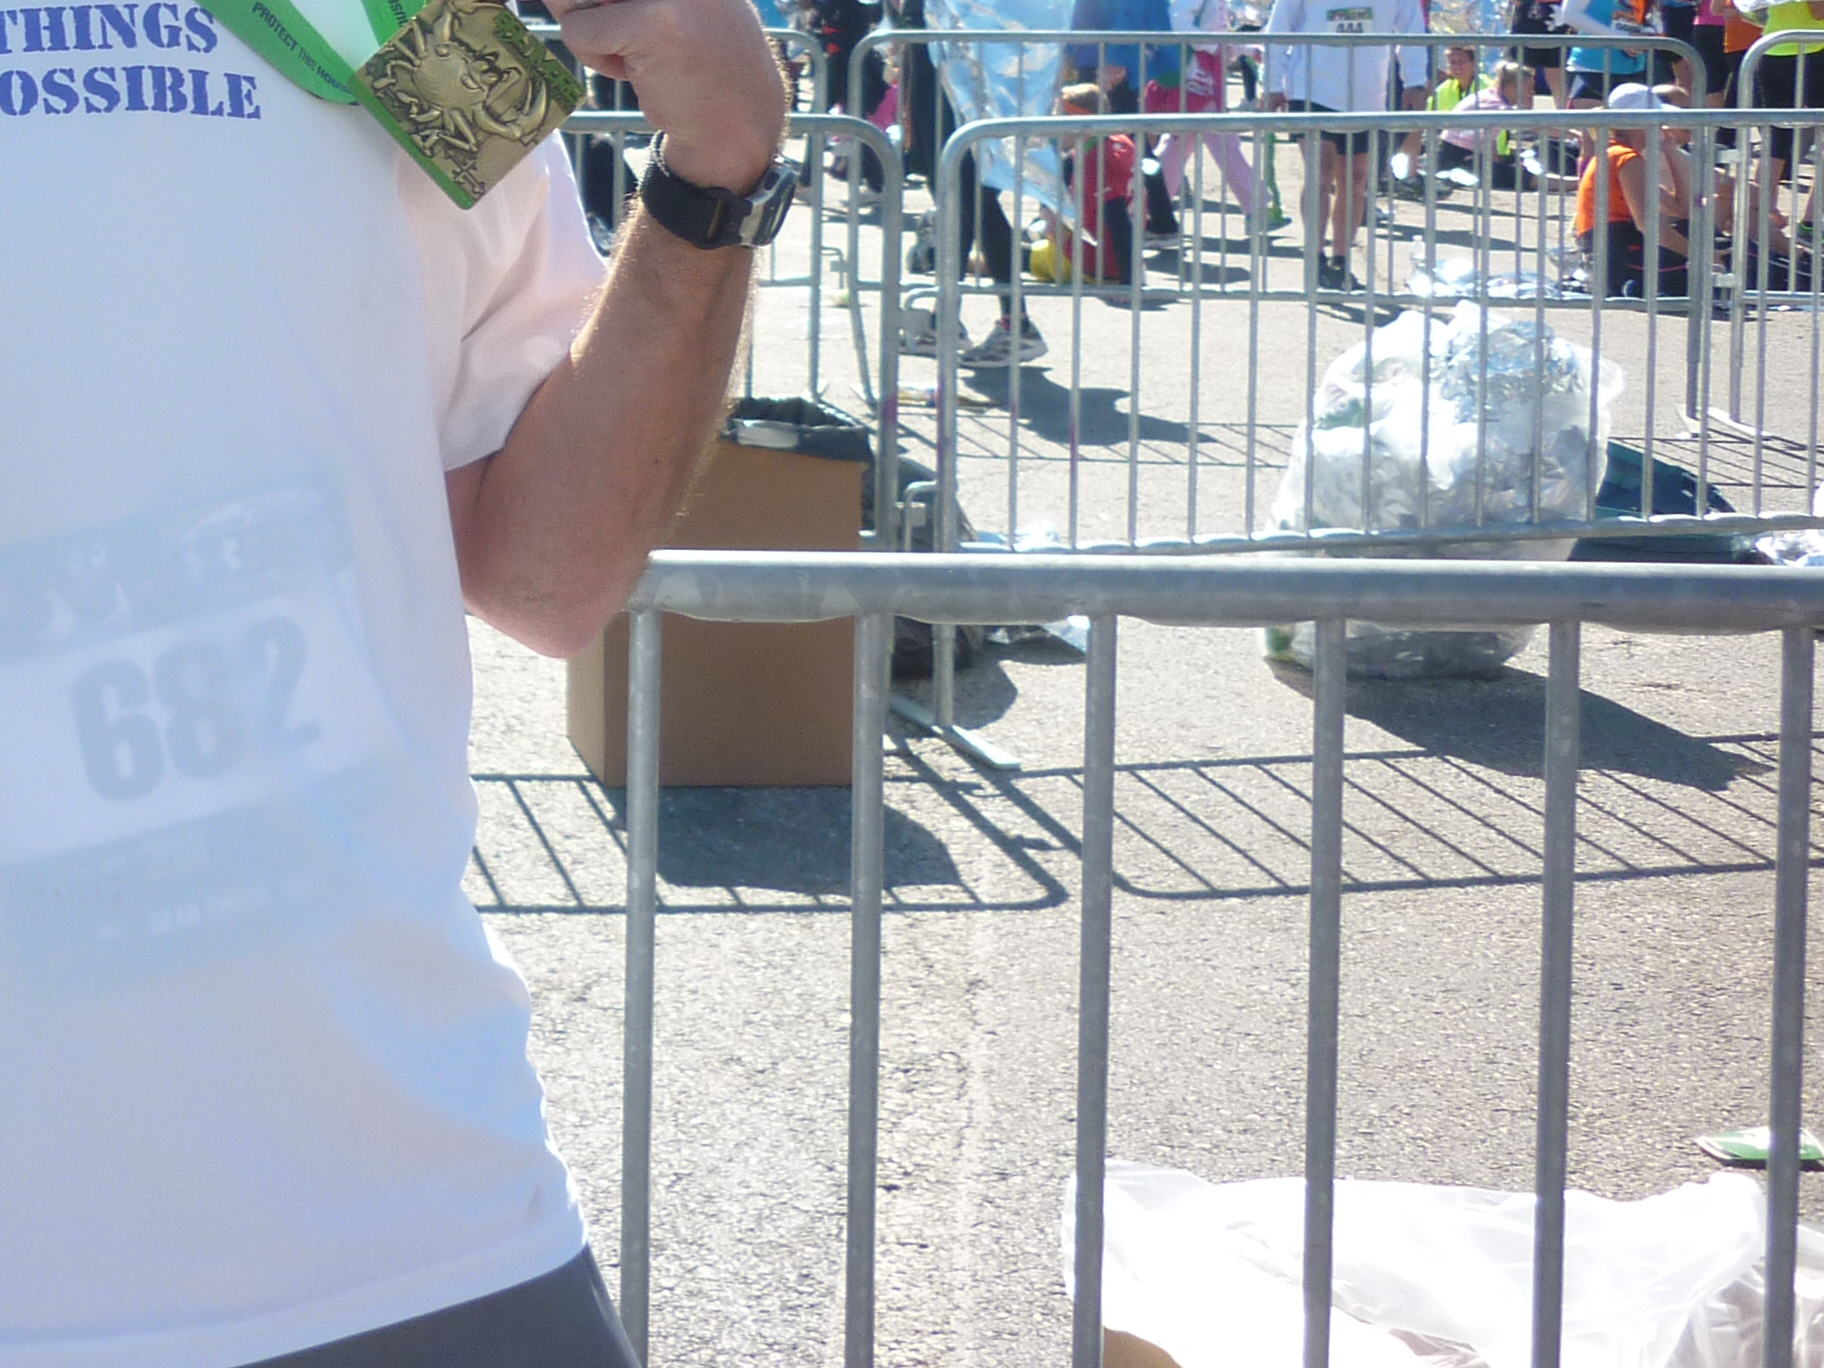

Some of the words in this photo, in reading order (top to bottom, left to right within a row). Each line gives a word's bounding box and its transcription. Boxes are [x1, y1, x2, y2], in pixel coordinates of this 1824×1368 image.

[250, 1, 299, 50] PROTECT
[297, 47, 318, 72] THIS
[70, 616, 323, 804] 682
